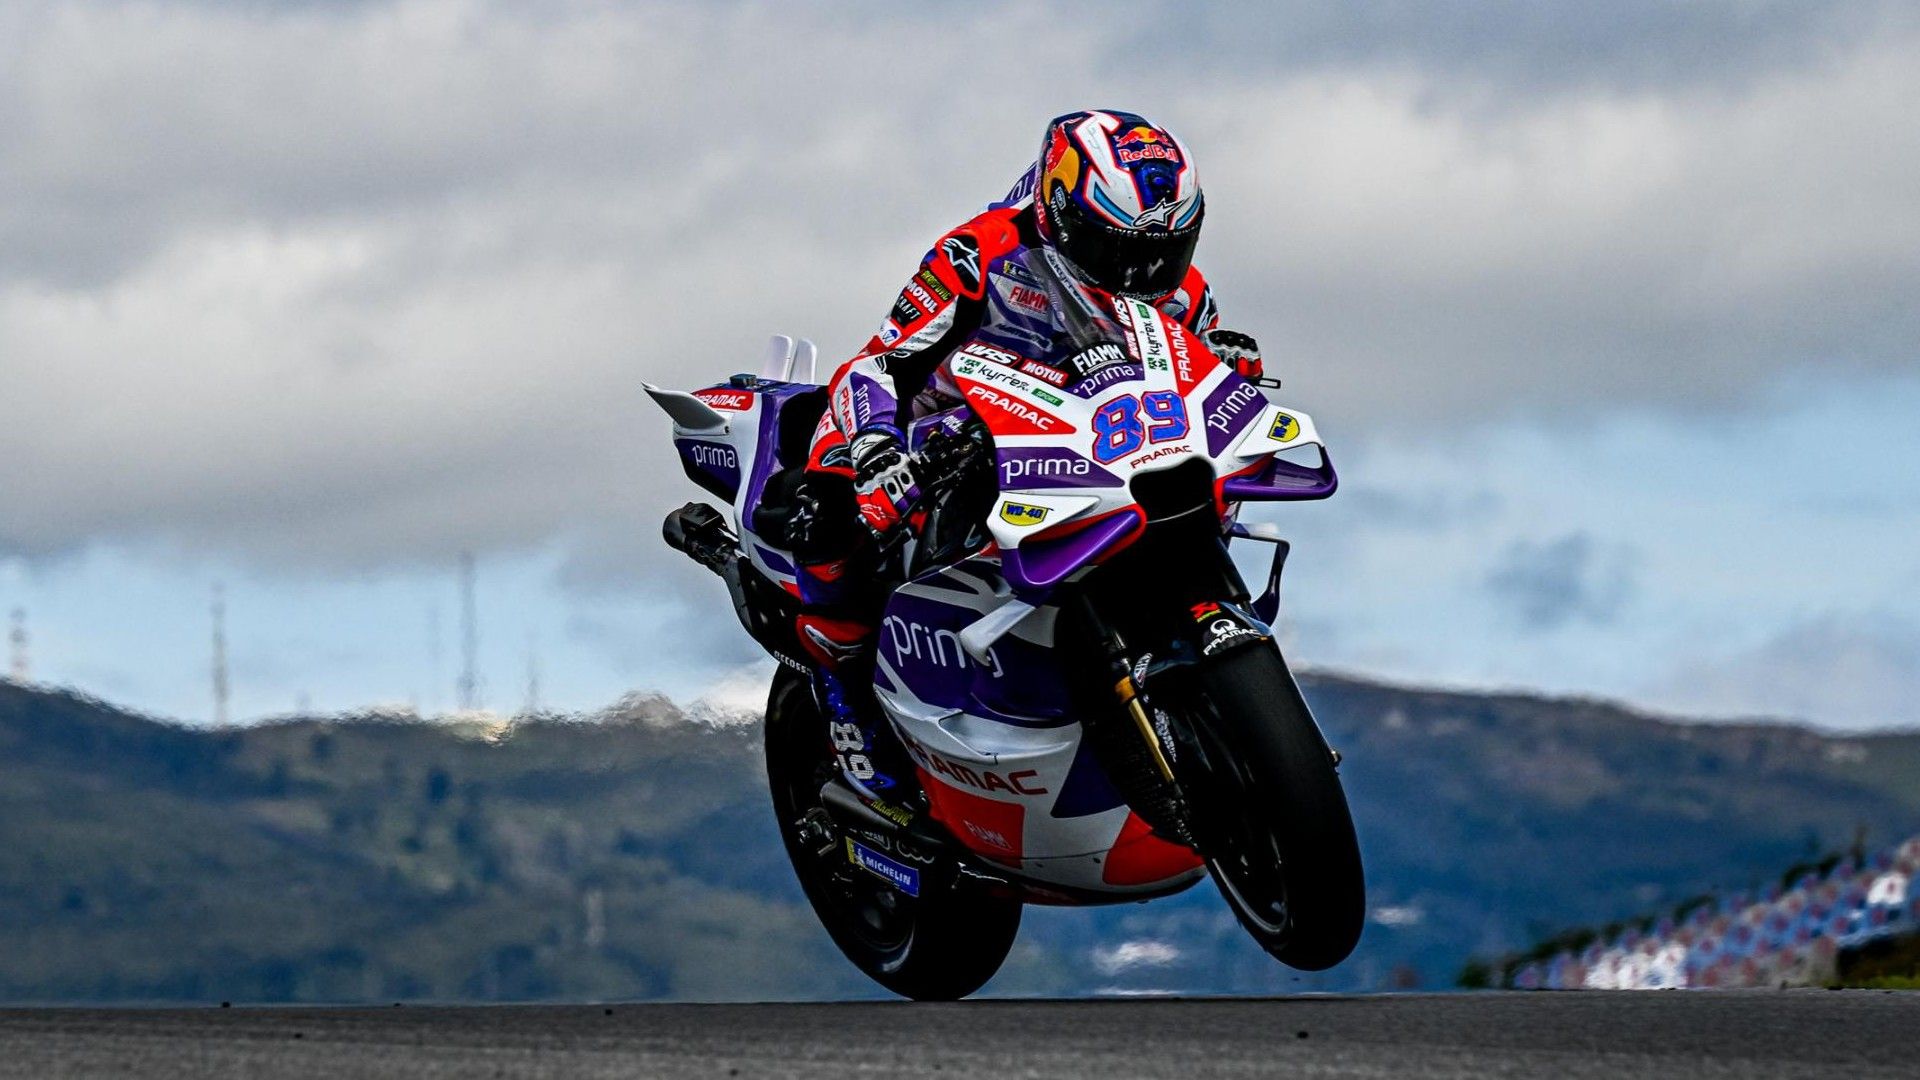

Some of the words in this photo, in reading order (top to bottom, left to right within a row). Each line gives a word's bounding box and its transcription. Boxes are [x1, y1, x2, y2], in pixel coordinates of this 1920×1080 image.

[1118, 144, 1152, 163] Red
[907, 281, 938, 313] MOTUL
[1072, 344, 1125, 374] FIAMM
[1167, 322, 1194, 382] PRAMAC
[978, 365, 1029, 391] kyrrex
[1022, 362, 1064, 384] MOTUL
[1081, 363, 1135, 396] prima
[967, 386, 1054, 431] PRAMAC
[1207, 382, 1257, 434] prima
[1092, 390, 1190, 465] 89
[692, 445, 736, 468] prima
[1000, 458, 1090, 484] prima
[1130, 445, 1192, 469] PRAMAC
[1006, 503, 1042, 517] WD-40
[1203, 629, 1259, 656] PRAMAC
[830, 721, 875, 780] 89
[866, 856, 912, 886] MICHELIN
